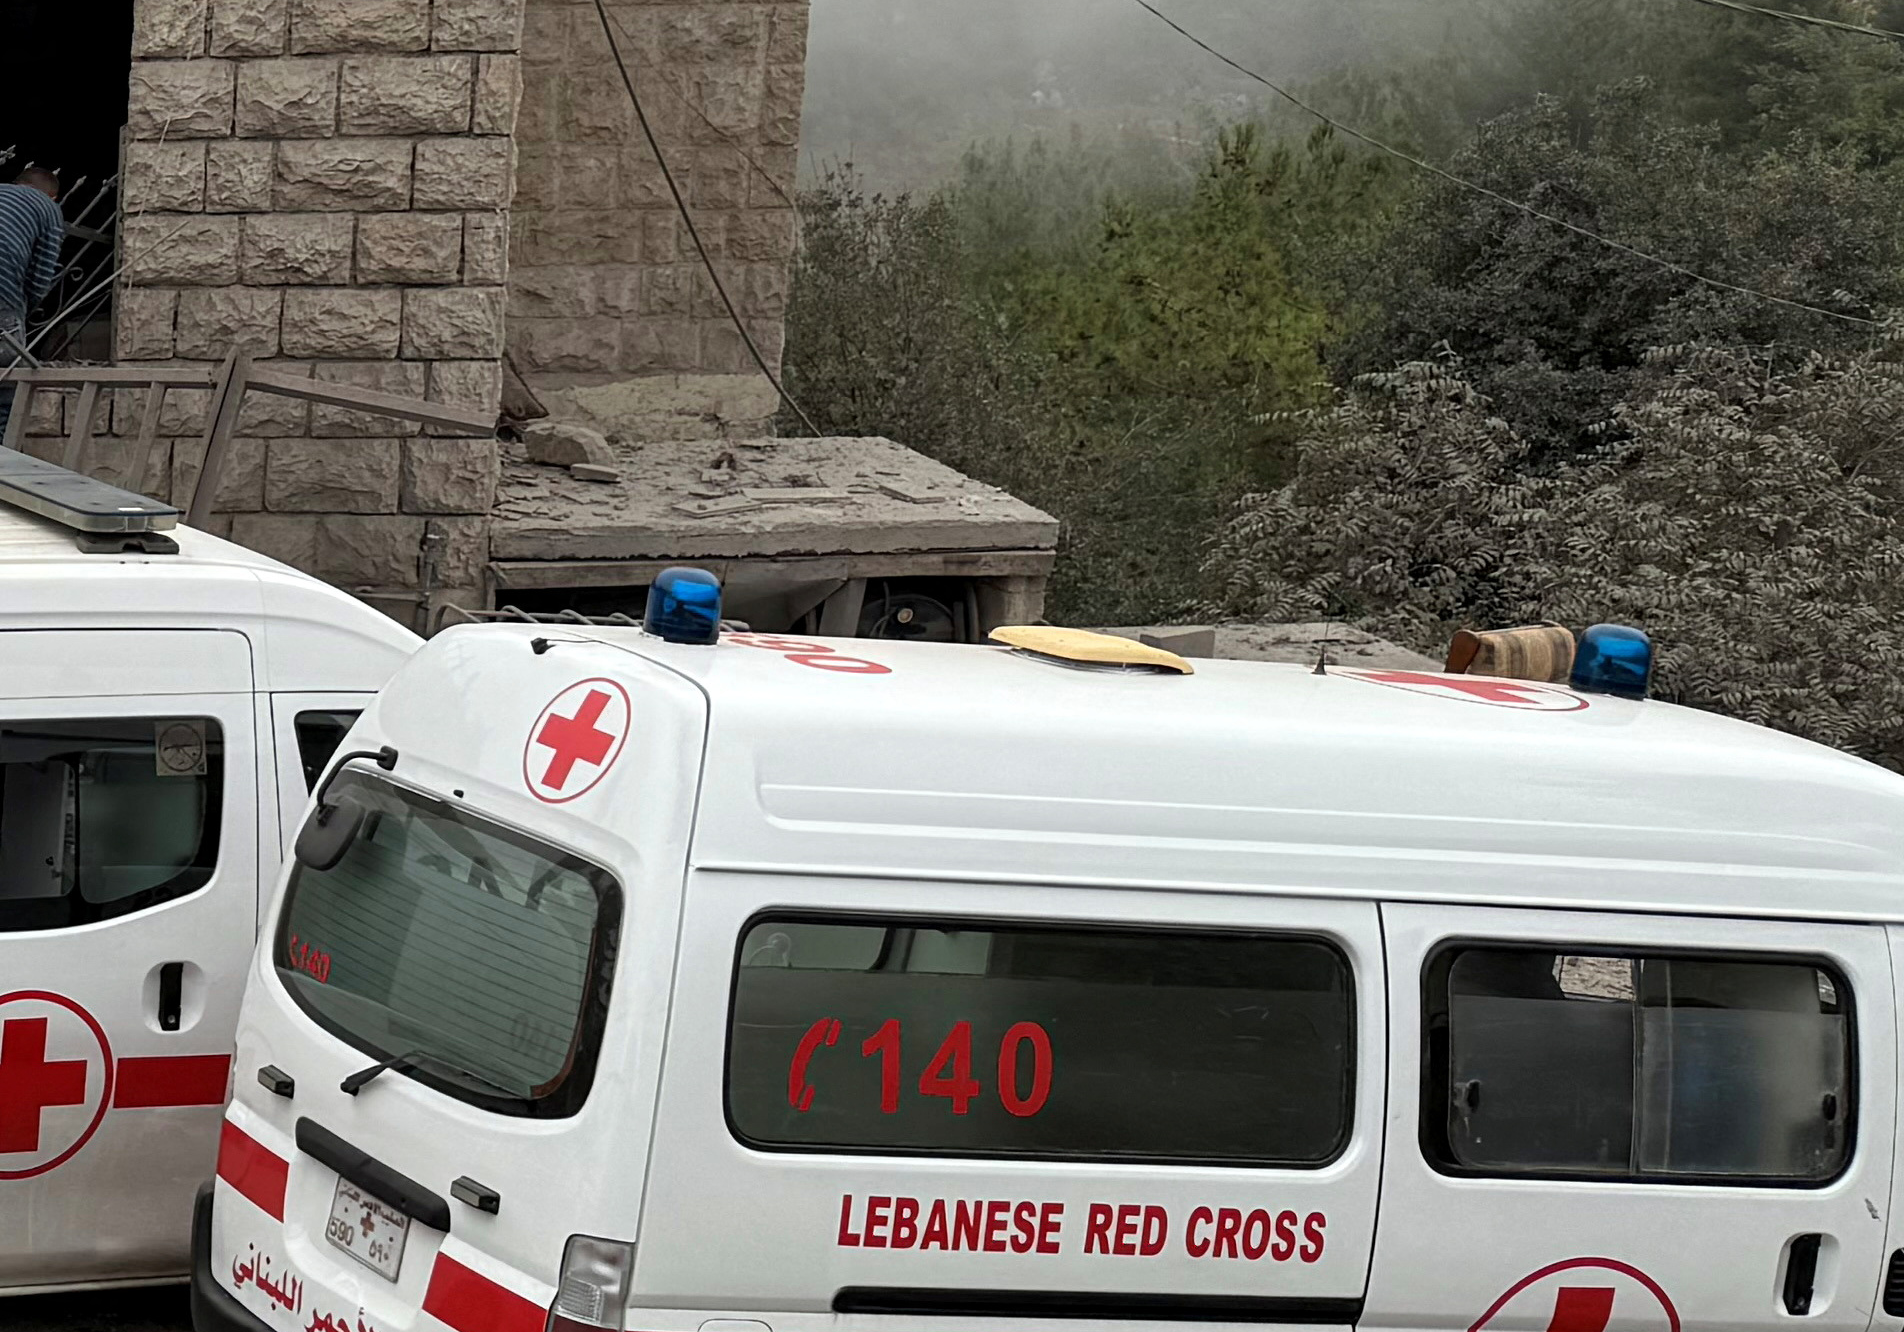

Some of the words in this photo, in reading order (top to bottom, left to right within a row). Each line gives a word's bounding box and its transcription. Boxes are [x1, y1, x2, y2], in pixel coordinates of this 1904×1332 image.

[300, 940, 332, 984] 140
[861, 1017, 1054, 1118] 140
[329, 1216, 355, 1247] 590
[837, 1194, 1064, 1254] LEBANESE
[1084, 1203, 1168, 1257] RED
[1185, 1207, 1327, 1264] CROSS
[232, 1242, 303, 1314] اللبناني
